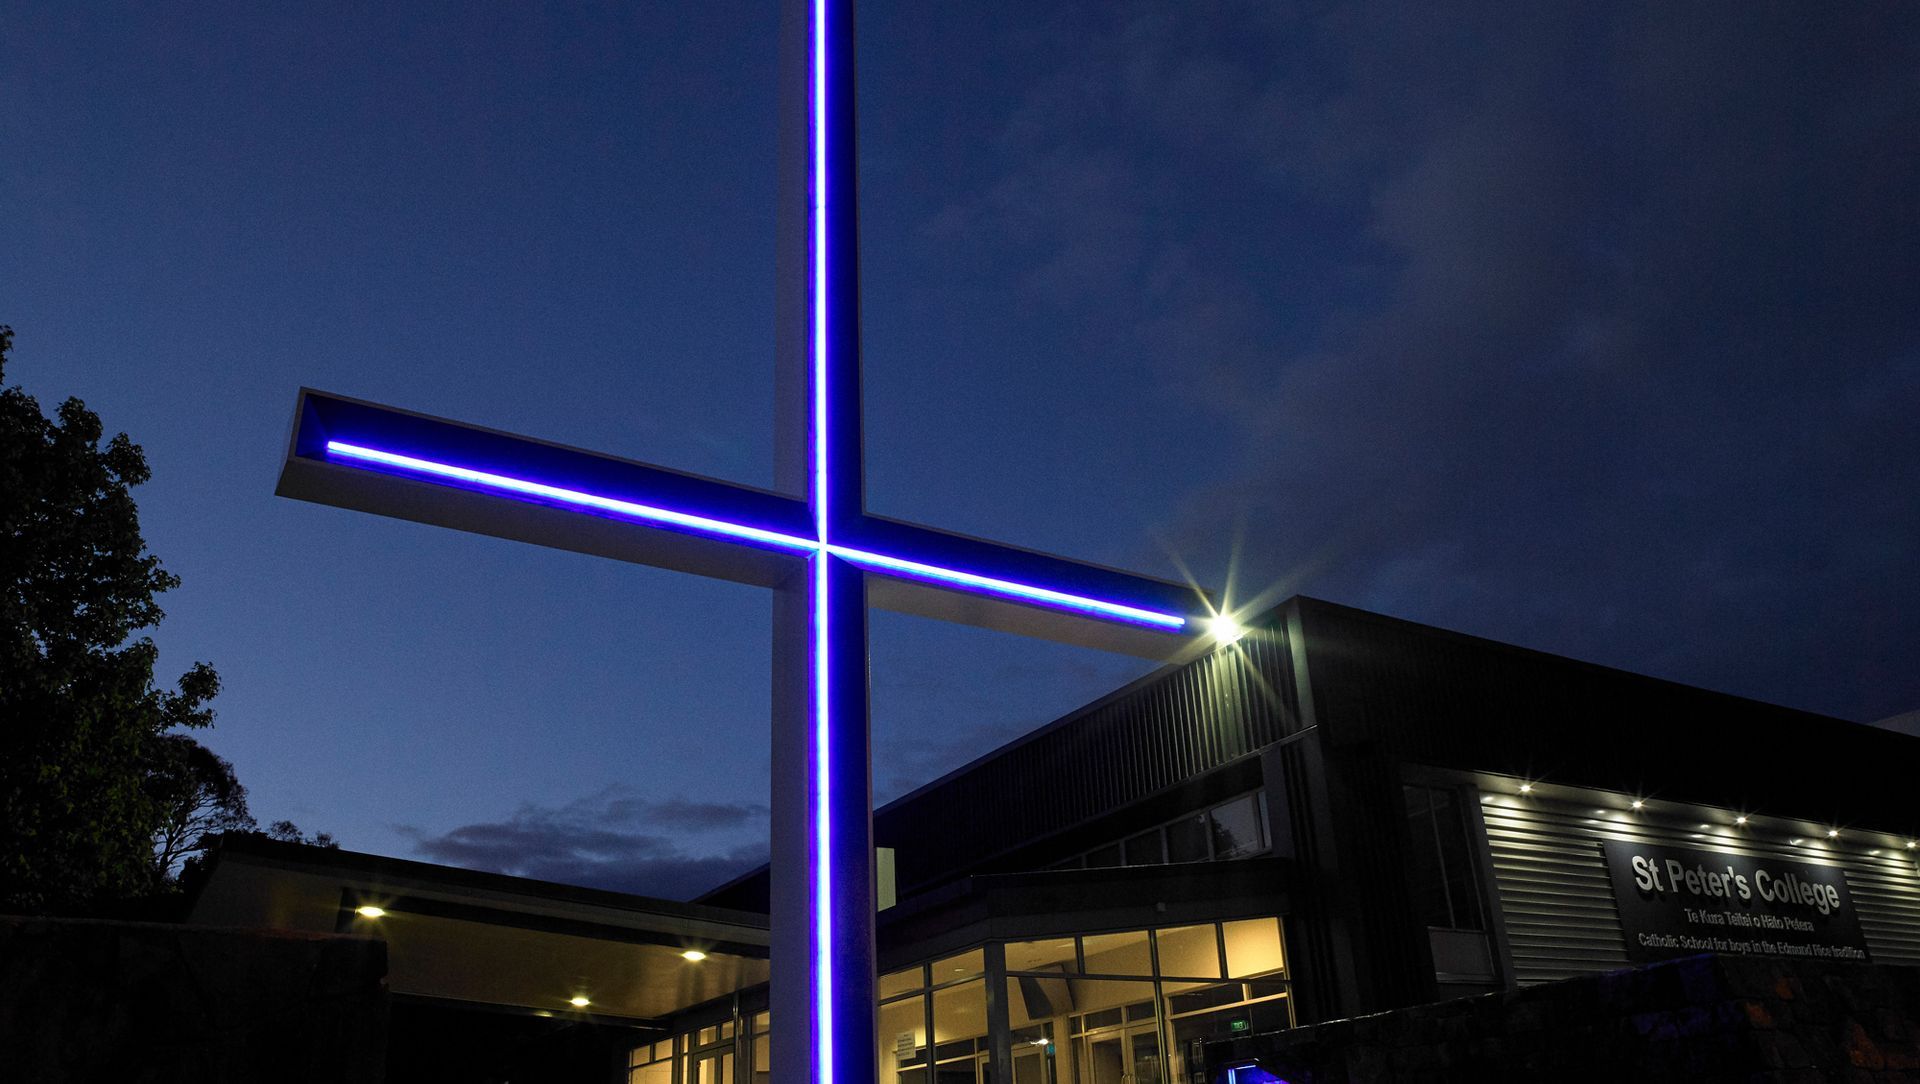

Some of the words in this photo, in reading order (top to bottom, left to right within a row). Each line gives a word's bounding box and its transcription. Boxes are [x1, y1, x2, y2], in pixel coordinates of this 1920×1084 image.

[1632, 855, 1664, 892] St
[1665, 859, 1751, 900] Peter's
[1755, 869, 1840, 915] College
[1684, 907, 1699, 923] Te
[1699, 909, 1725, 925] Kura
[1753, 917, 1761, 927] o
[1783, 916, 1815, 932] Petera
[1638, 932, 1679, 948] Catholic
[1679, 935, 1714, 950] School
[1713, 937, 1728, 951] for
[1728, 938, 1752, 956] boys
[1751, 939, 1762, 953] in
[1761, 940, 1777, 954] the
[1776, 941, 1813, 956] Edmund
[1812, 943, 1832, 957] Rice
[1831, 945, 1866, 959] tradition
